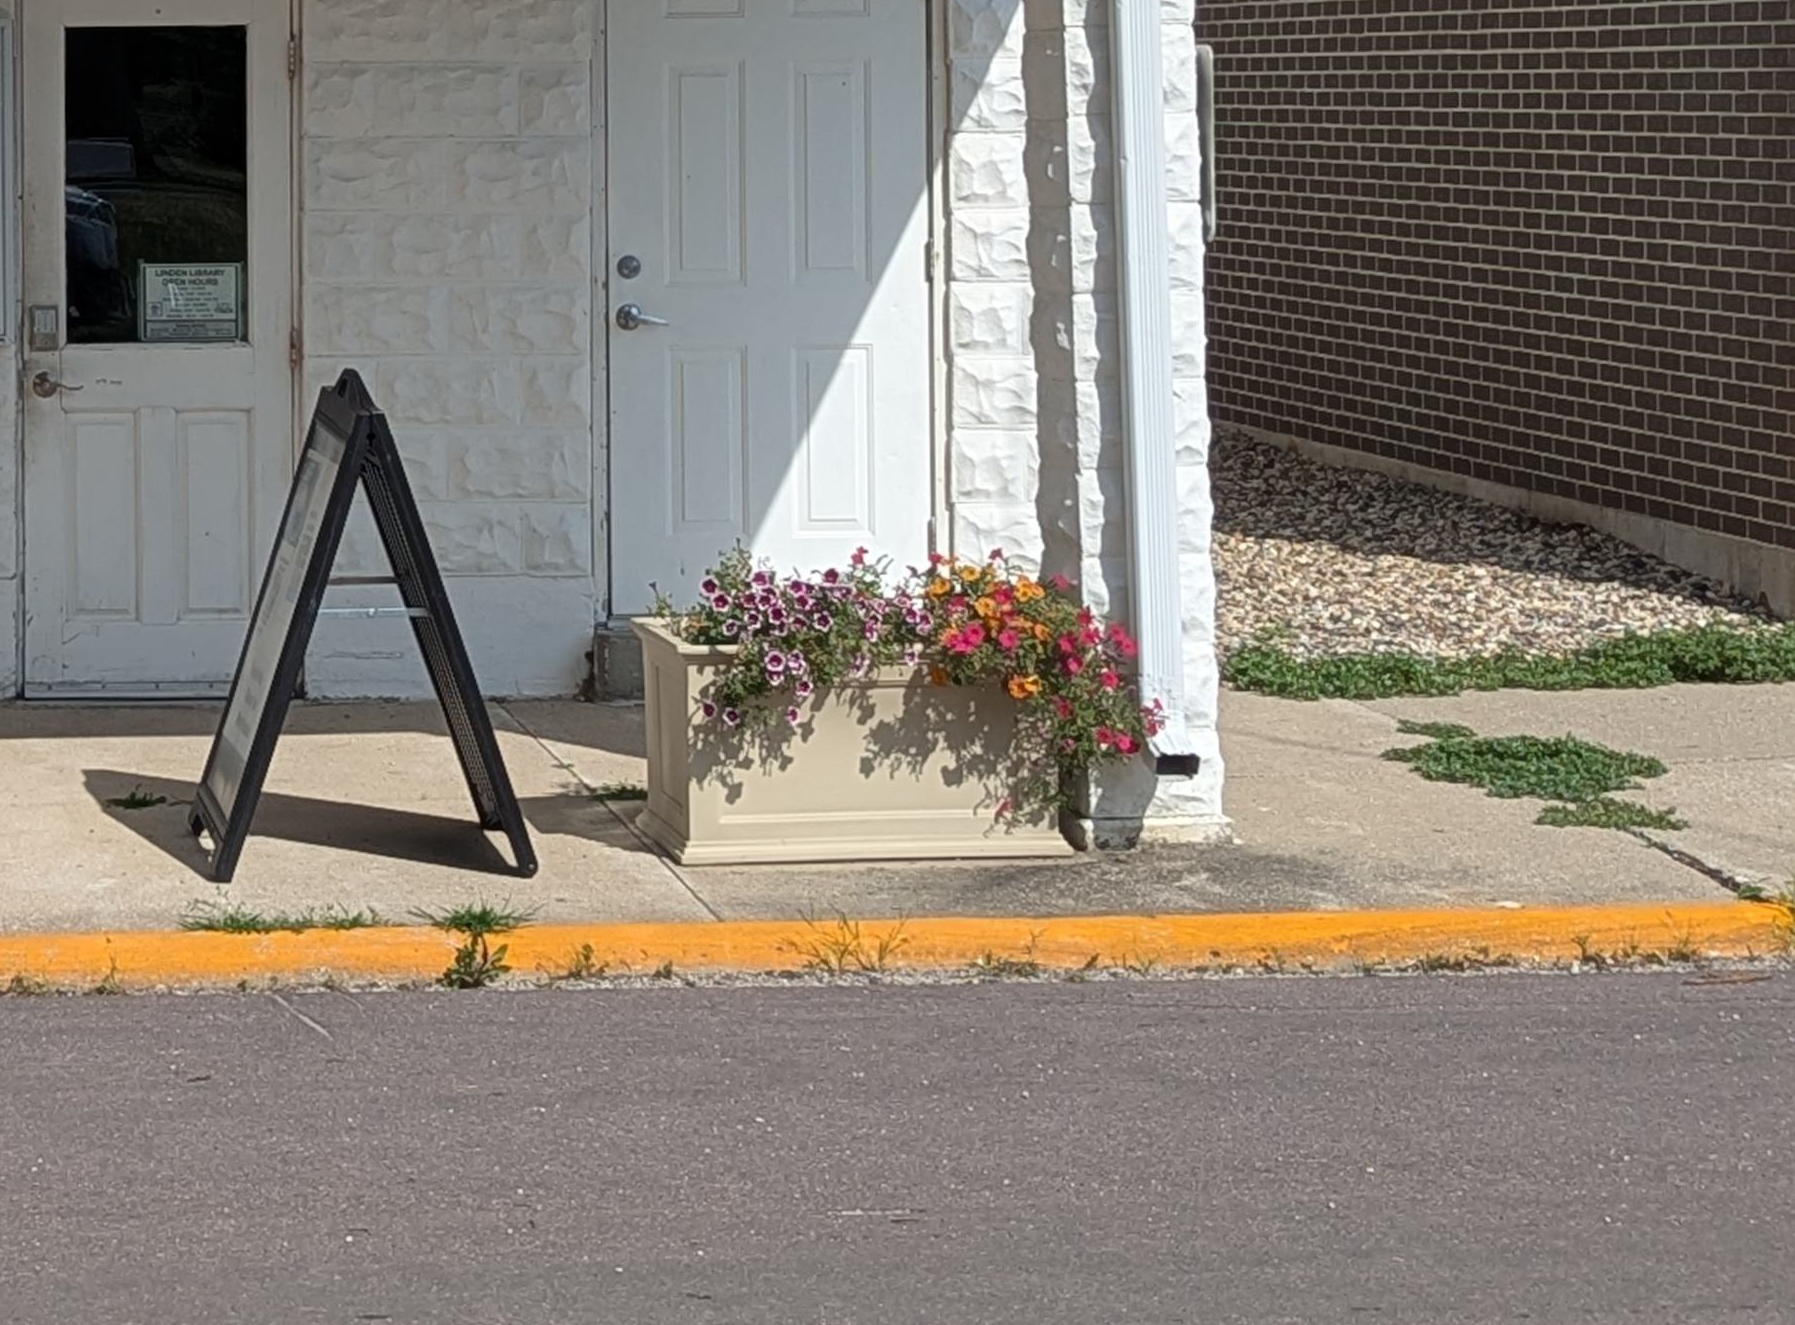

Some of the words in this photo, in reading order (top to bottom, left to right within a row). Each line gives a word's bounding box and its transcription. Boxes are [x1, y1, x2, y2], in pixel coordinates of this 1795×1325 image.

[155, 269, 187, 277] LINDEN
[189, 269, 225, 277] LIBRARY
[188, 278, 218, 286] HOURS
